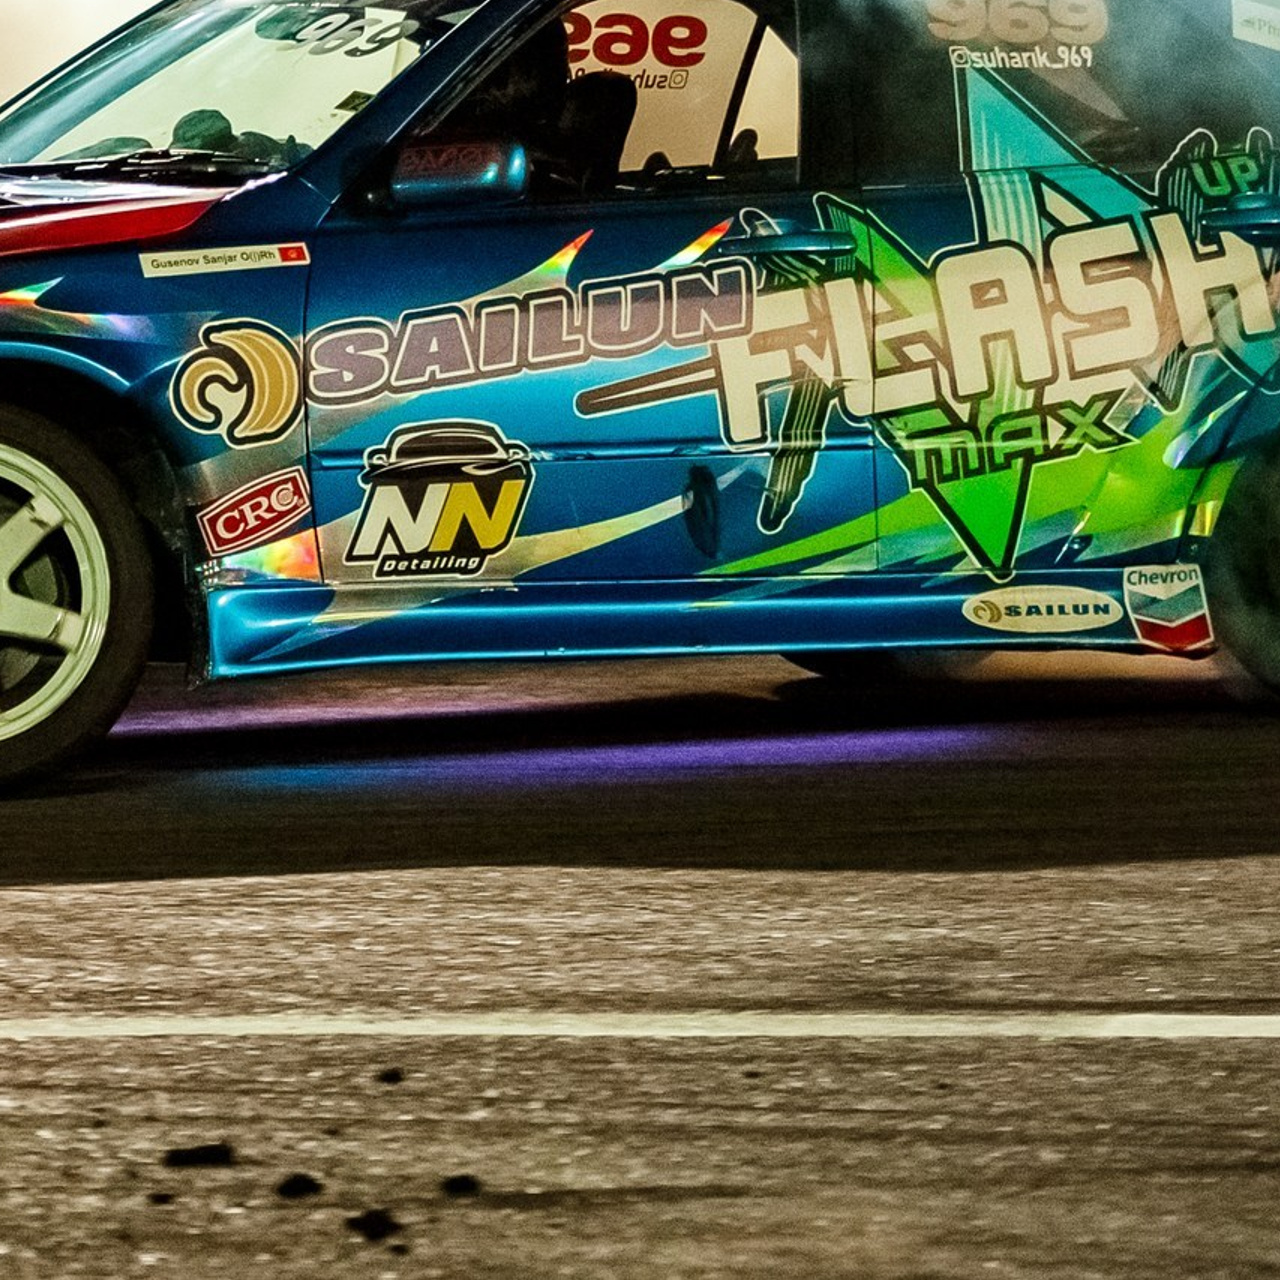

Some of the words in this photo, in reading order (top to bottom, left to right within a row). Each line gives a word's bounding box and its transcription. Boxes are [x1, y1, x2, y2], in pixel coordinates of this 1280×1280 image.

[1190, 155, 1260, 197] UP
[306, 261, 753, 404] SAILUN
[718, 211, 1276, 442] FLASH
[902, 399, 1115, 480] MAX
[216, 481, 299, 540] CRC
[352, 479, 526, 556] NN
[382, 555, 481, 571] Detailing
[1126, 568, 1200, 586] Chevron
[1004, 603, 1111, 617] SAILUN
